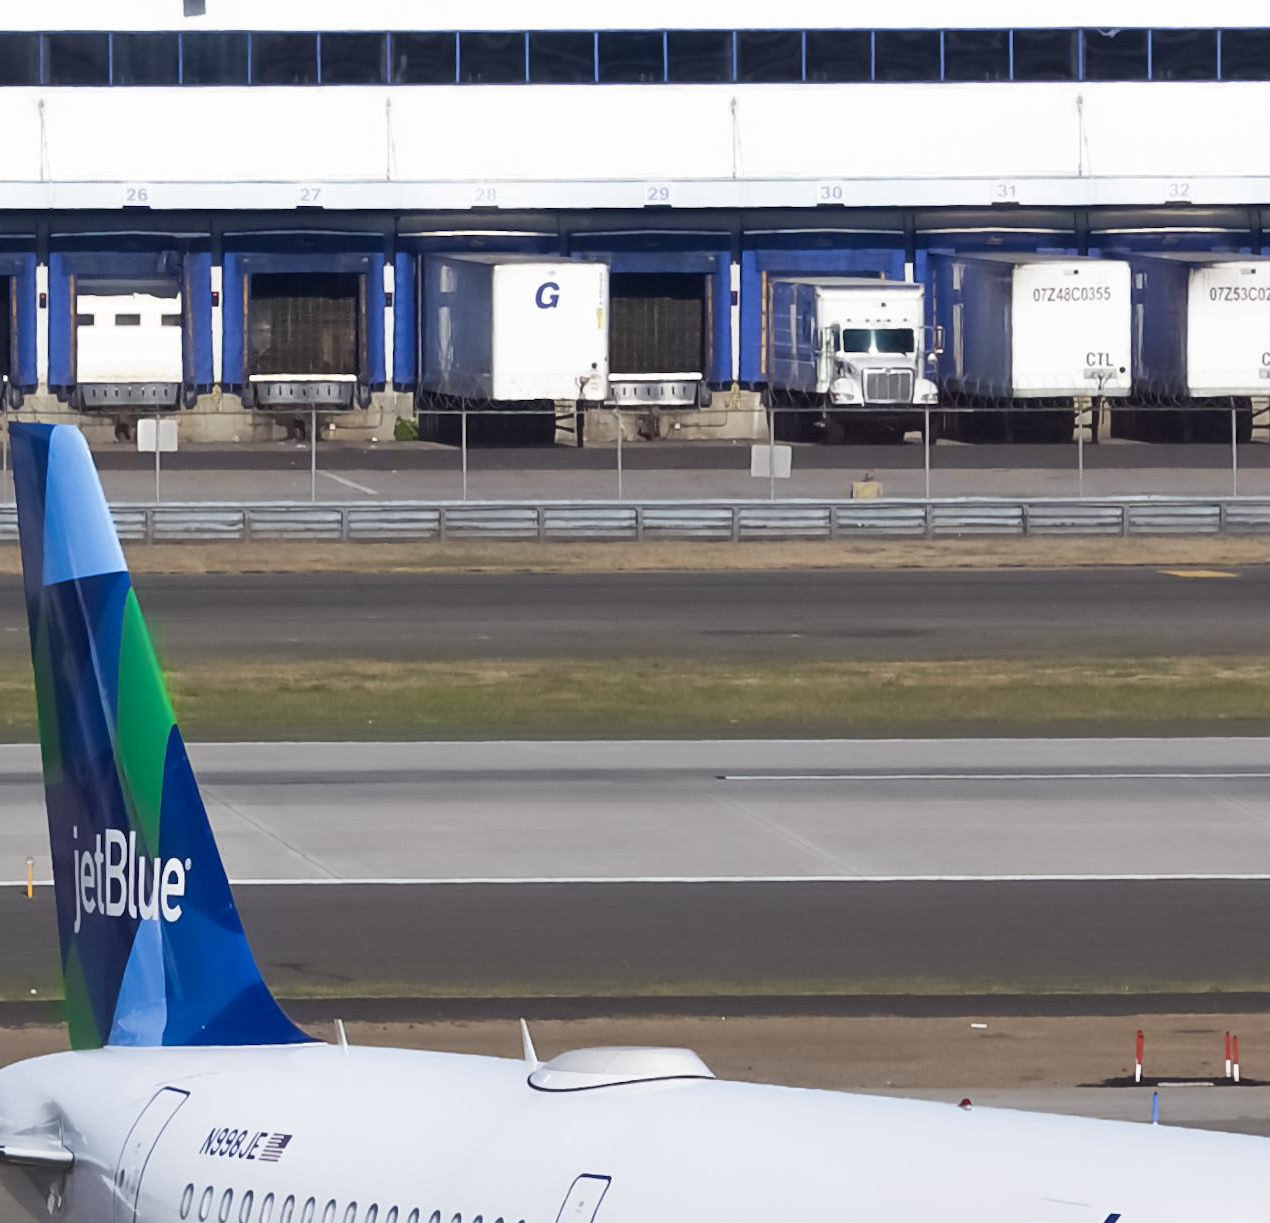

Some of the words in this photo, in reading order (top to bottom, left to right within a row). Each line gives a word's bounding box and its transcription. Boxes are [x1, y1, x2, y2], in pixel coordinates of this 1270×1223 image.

[126, 188, 148, 201] 26
[300, 188, 321, 201] 27
[475, 188, 497, 201] 28
[648, 188, 669, 201] 29
[821, 187, 843, 200] 30
[997, 184, 1017, 198] 31
[1169, 183, 1190, 197] 32
[535, 281, 560, 309] G
[1033, 286, 1111, 302] 07Z48C0355
[1086, 352, 1114, 367] CTL
[73, 825, 186, 934] jetBlue
[198, 1127, 268, 1160] N998JE
